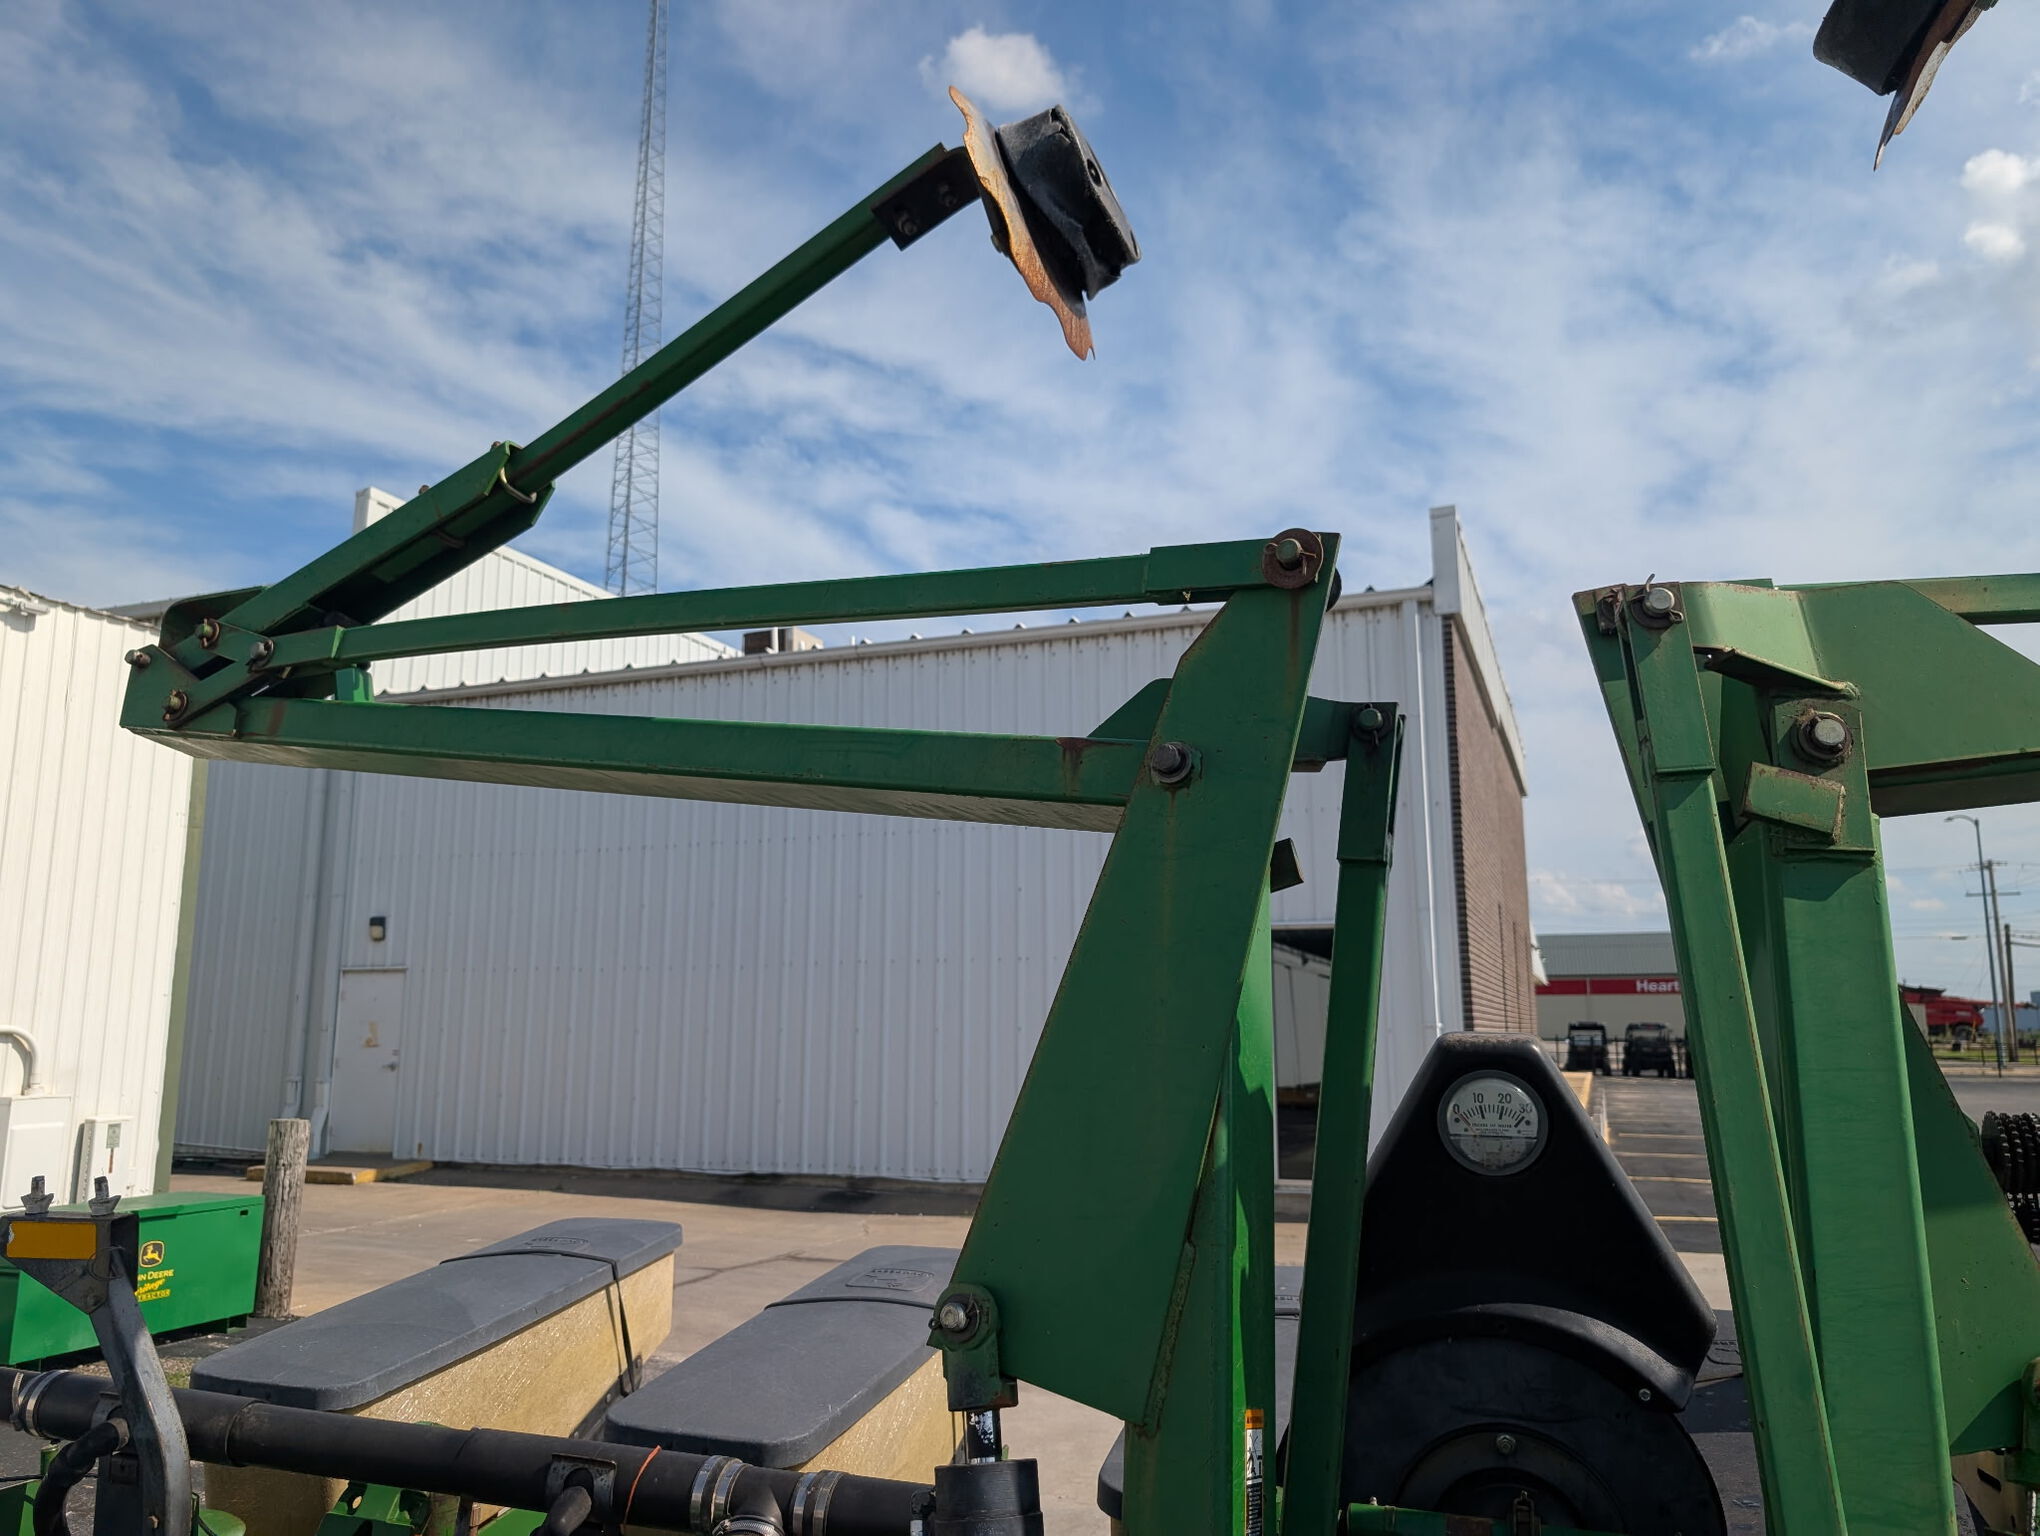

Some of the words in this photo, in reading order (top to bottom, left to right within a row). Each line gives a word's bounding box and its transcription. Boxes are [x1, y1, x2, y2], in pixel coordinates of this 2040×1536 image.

[1636, 979, 1680, 992] Heart
[1472, 1092, 1484, 1104] 10
[1497, 1092, 1512, 1104] 20
[1452, 1103, 1461, 1115] 0
[1518, 1102, 1533, 1114] 30
[147, 1269, 174, 1280] DEERE
